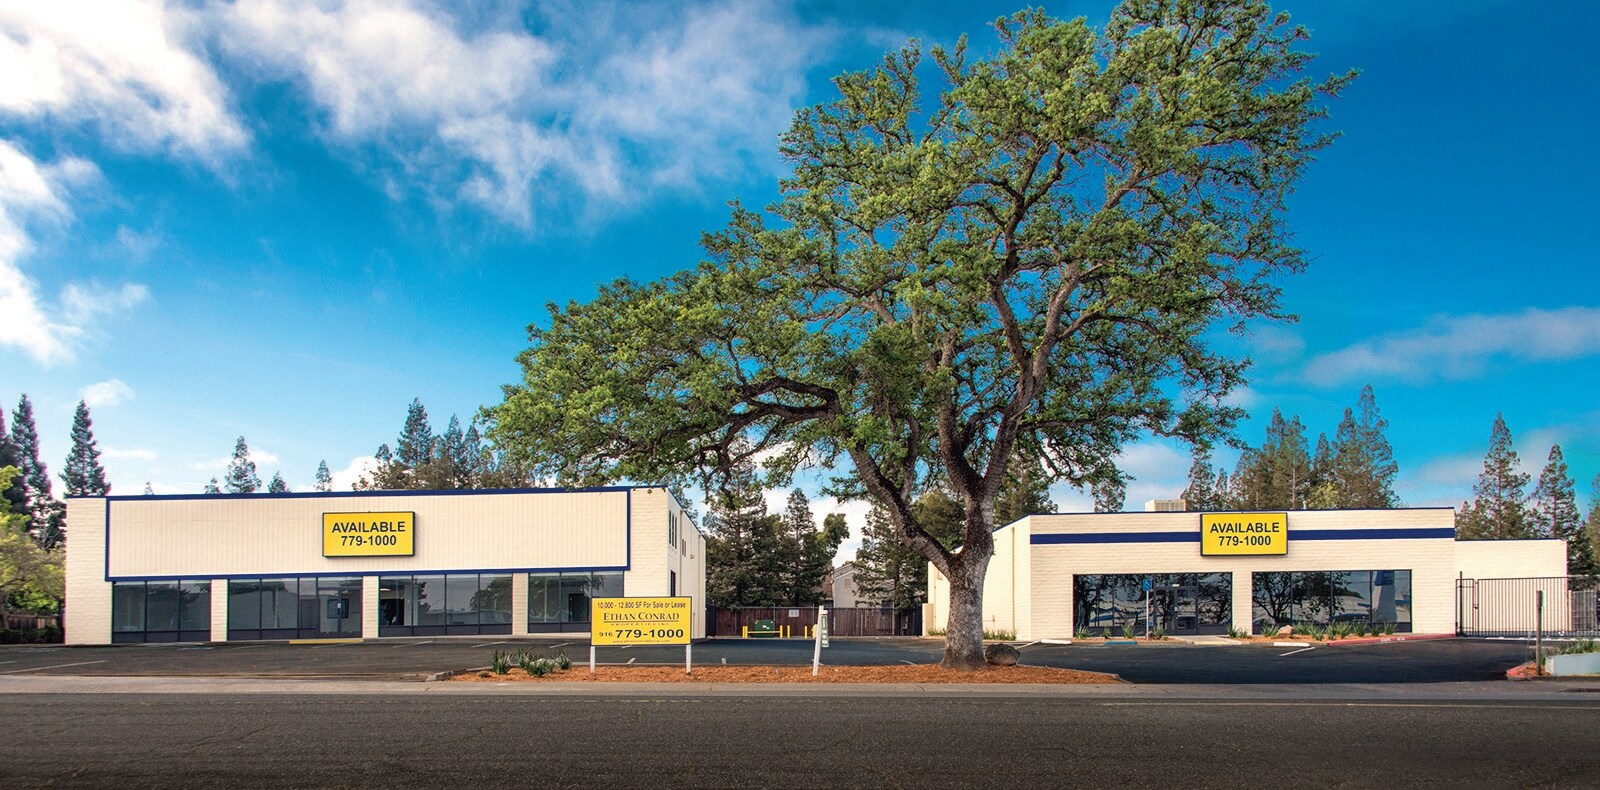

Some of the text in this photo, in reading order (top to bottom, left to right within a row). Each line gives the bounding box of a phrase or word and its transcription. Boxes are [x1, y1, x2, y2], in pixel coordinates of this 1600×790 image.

[332, 521, 405, 533] AVAILABLE
[1210, 522, 1279, 533] AVAILABLE
[341, 535, 396, 546] 779-1000
[1219, 535, 1271, 546] 779-1000
[616, 629, 684, 638] 779-1000
